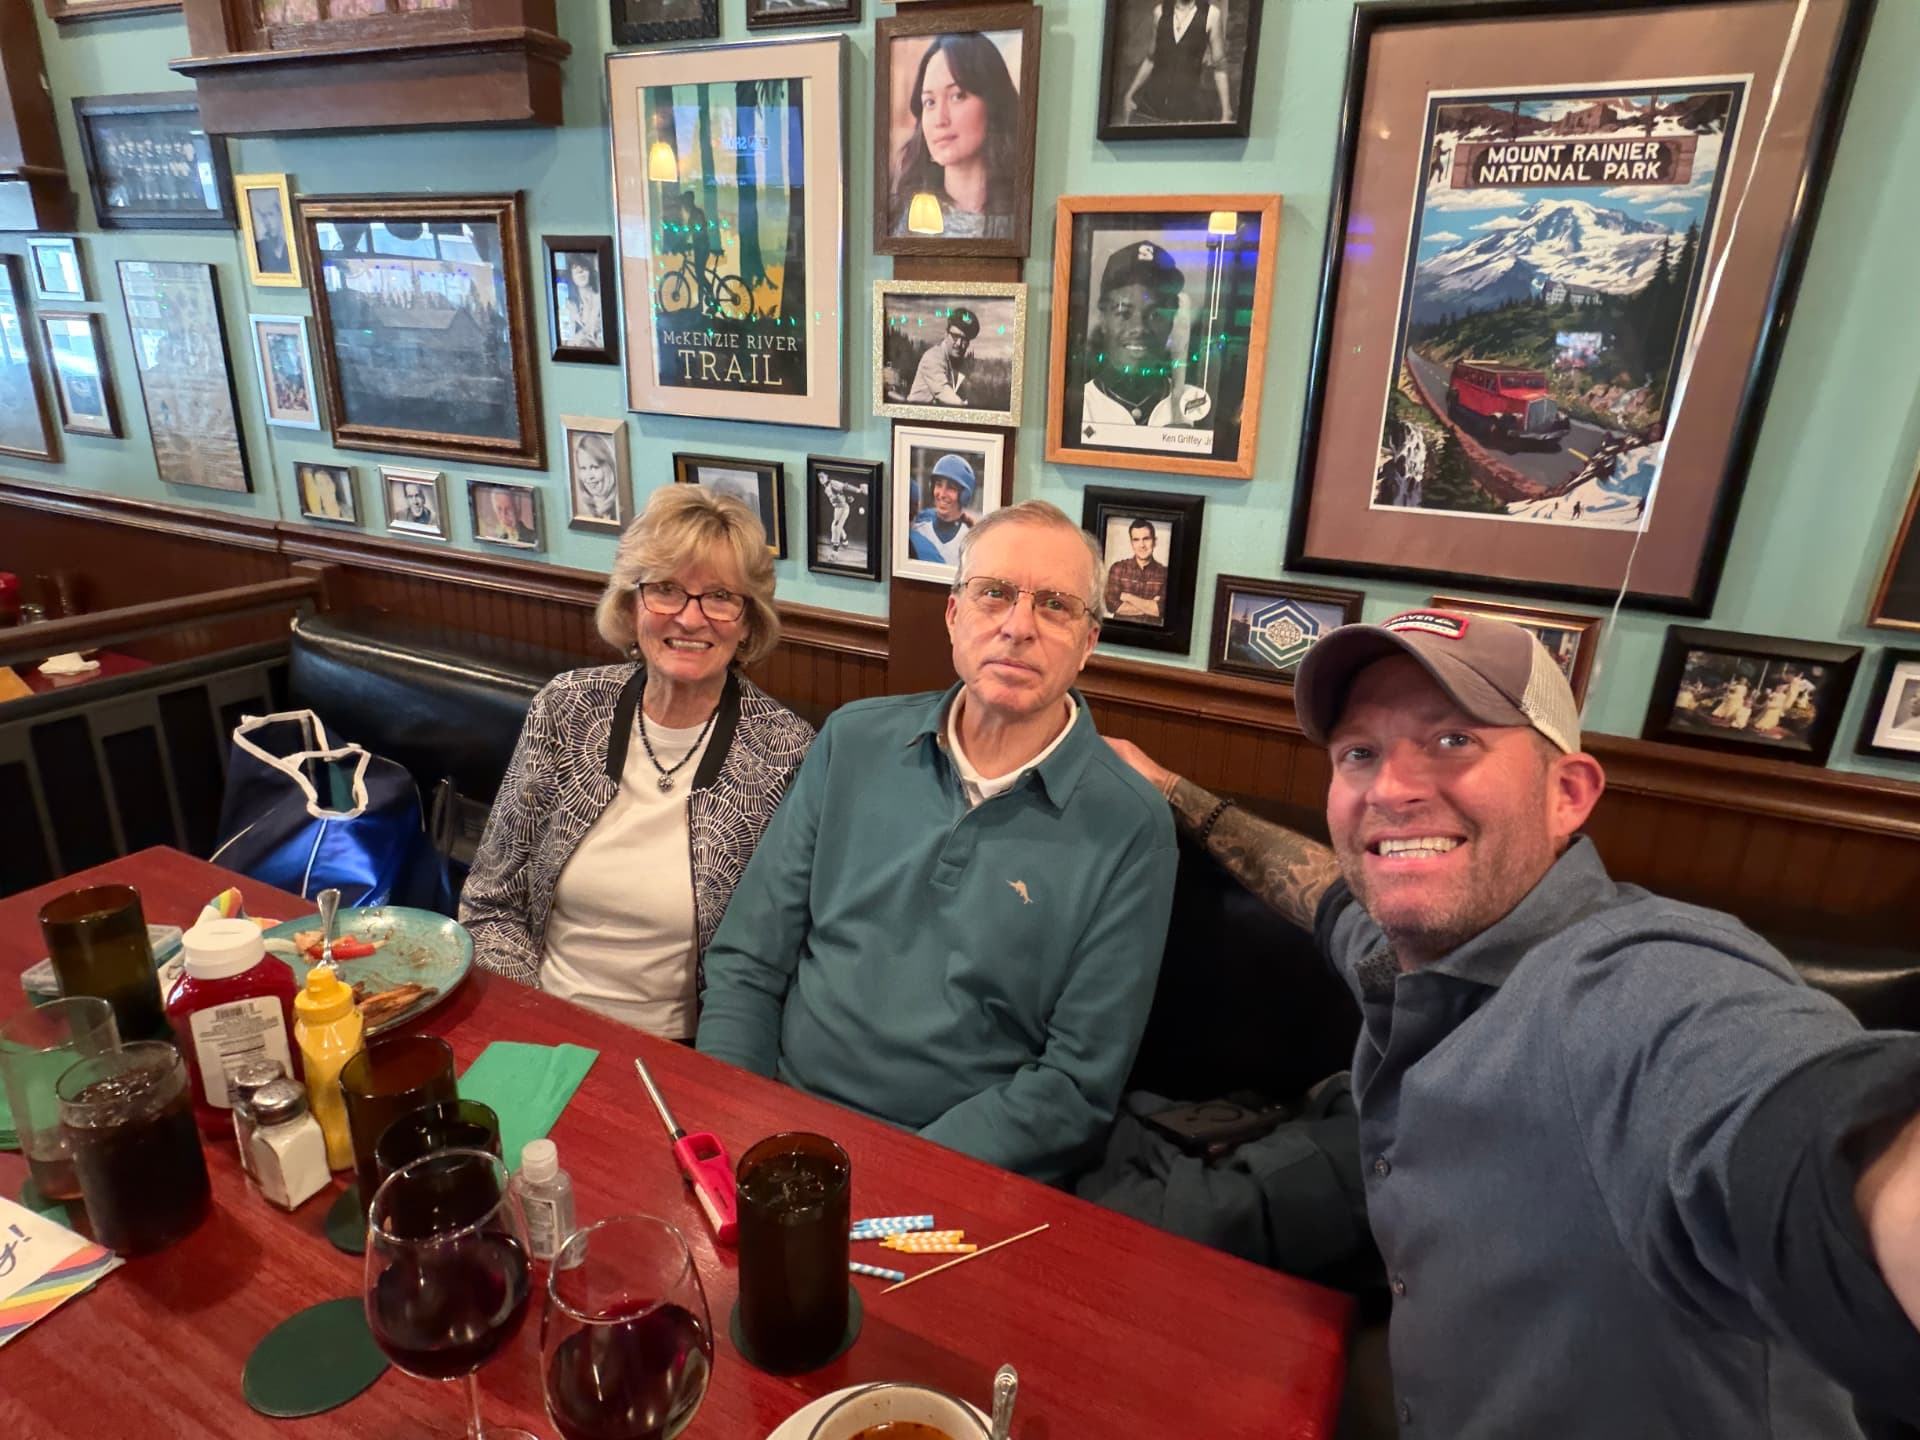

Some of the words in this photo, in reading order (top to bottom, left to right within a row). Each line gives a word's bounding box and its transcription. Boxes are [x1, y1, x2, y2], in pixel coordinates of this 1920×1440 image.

[1487, 145, 1566, 164] MOUNT
[1572, 142, 1661, 163] RAINIER
[1479, 162, 1592, 184] NATIONAL
[1603, 161, 1662, 181] PARK
[747, 334, 798, 352] RIVER
[677, 349, 783, 386] TRAIL
[1162, 433, 1176, 444] Ken
[1177, 434, 1202, 447] Griffey
